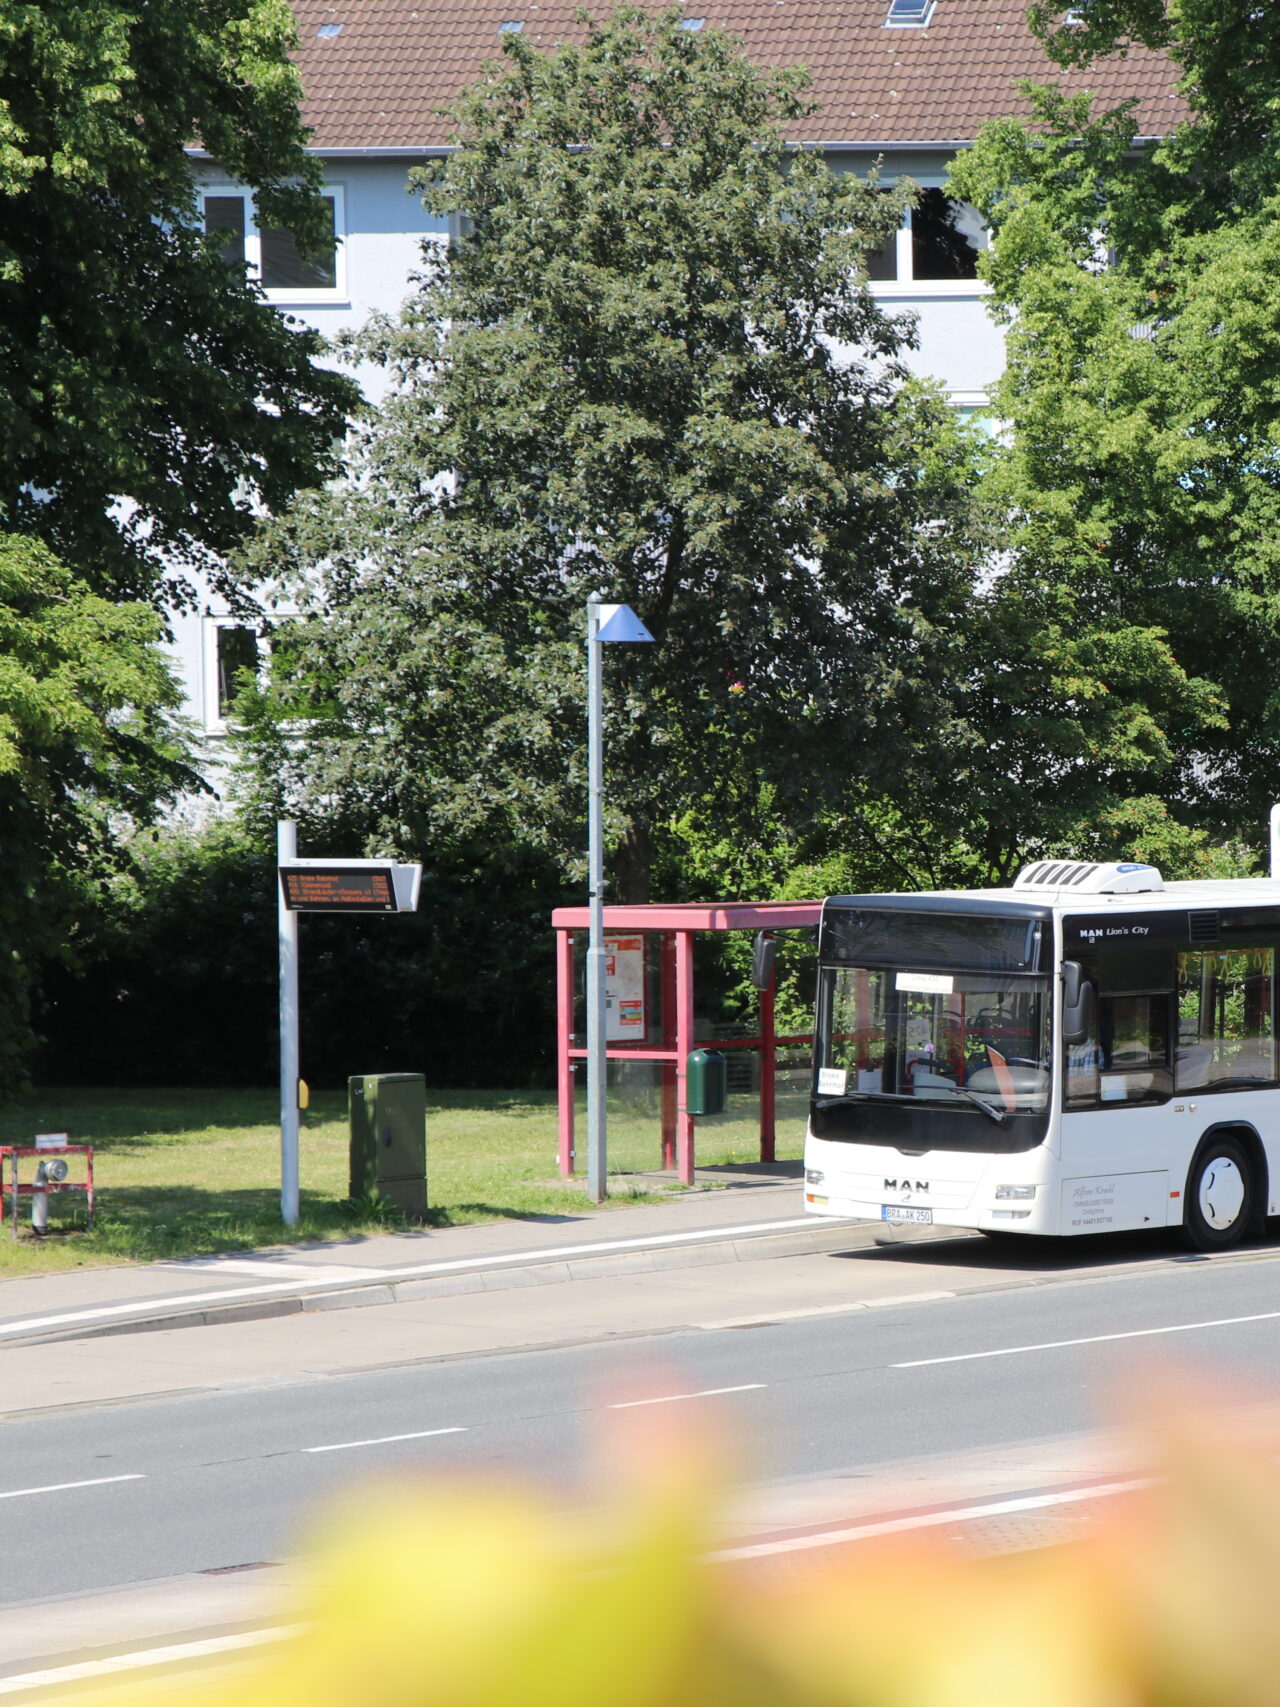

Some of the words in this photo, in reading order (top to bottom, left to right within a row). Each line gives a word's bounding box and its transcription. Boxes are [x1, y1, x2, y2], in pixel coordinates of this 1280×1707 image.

[1080, 929, 1103, 937] MAN
[1106, 927, 1128, 936] Lion's
[1131, 926, 1149, 936] City
[884, 1178, 929, 1193] MAN
[887, 1208, 900, 1219] BRA
[906, 1210, 915, 1221] AK
[916, 1211, 930, 1222] 250
